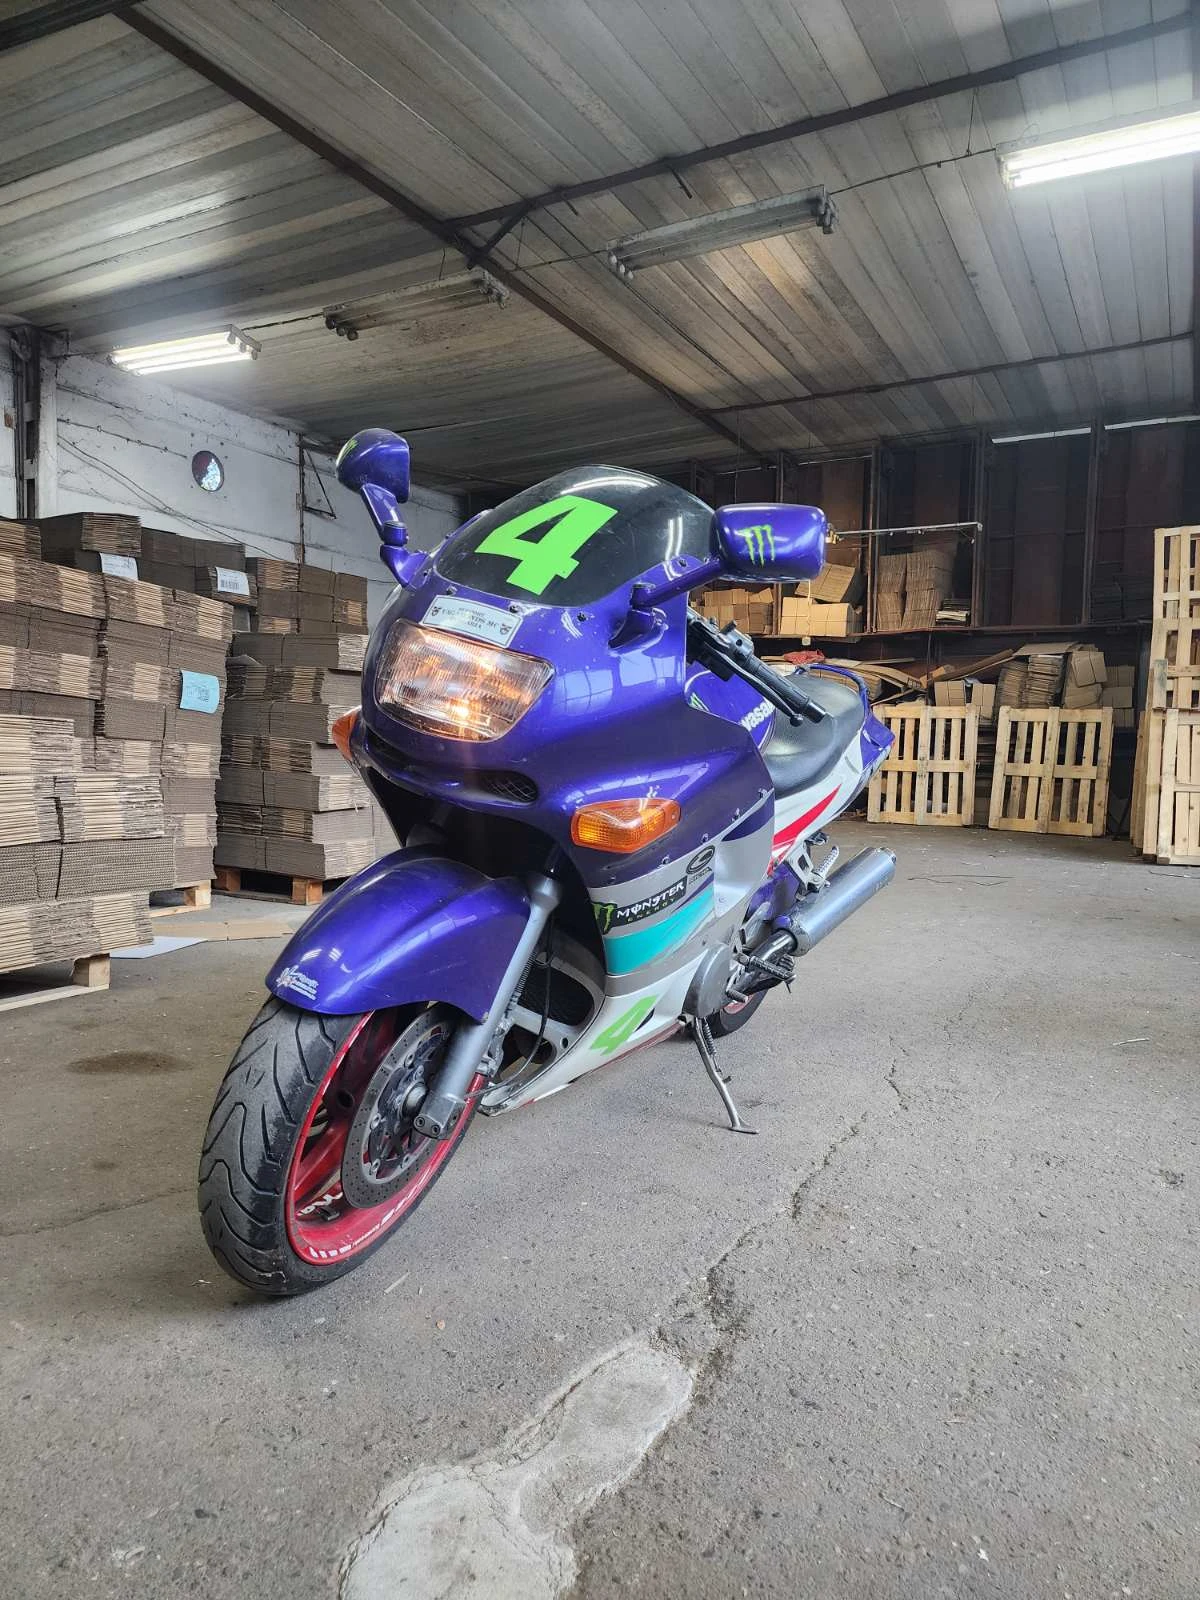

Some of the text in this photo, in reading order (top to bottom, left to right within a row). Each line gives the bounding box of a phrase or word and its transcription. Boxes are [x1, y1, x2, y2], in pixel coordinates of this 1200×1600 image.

[475, 495, 618, 595] 4
[616, 881, 685, 918] MONSTER
[590, 995, 657, 1056] 4
